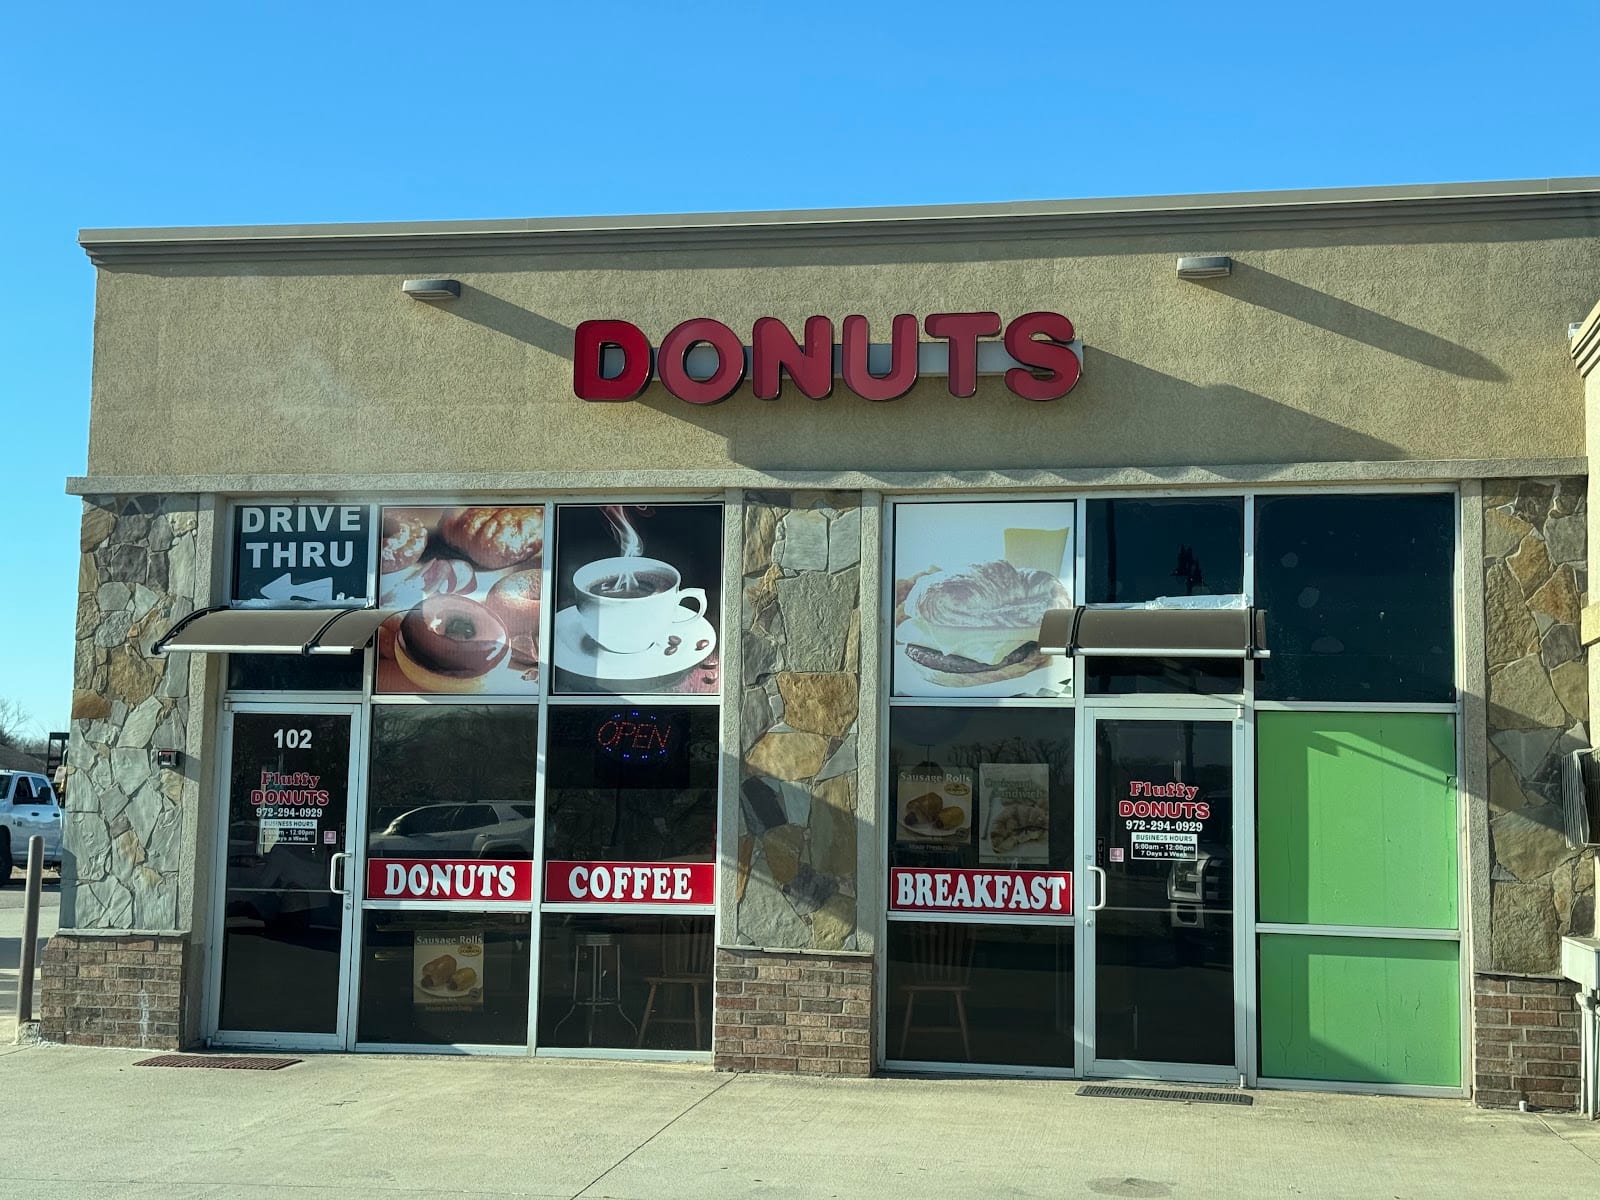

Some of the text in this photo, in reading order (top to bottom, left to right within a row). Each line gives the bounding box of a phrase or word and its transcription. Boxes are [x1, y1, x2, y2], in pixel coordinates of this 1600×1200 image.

[574, 311, 1084, 404] DONUTS
[241, 506, 361, 533] DRIVE
[245, 541, 354, 568] THRU
[273, 729, 313, 749] 102
[597, 720, 671, 749] OPEN
[260, 772, 320, 788] Fluffy
[900, 771, 971, 784] Sausage Rolls
[250, 789, 329, 806] DONUTS
[1130, 781, 1199, 800] Fluffy
[256, 807, 323, 818] 972-294-0929
[1119, 800, 1210, 819] DONUTS
[1126, 820, 1203, 832] 972-294-0929
[1169, 834, 1193, 842] HOURS
[384, 863, 516, 897] DONUTS
[568, 865, 693, 900] COFFEE
[896, 873, 1066, 910] BREAKFAST
[416, 935, 484, 946] Sausage Rolls
